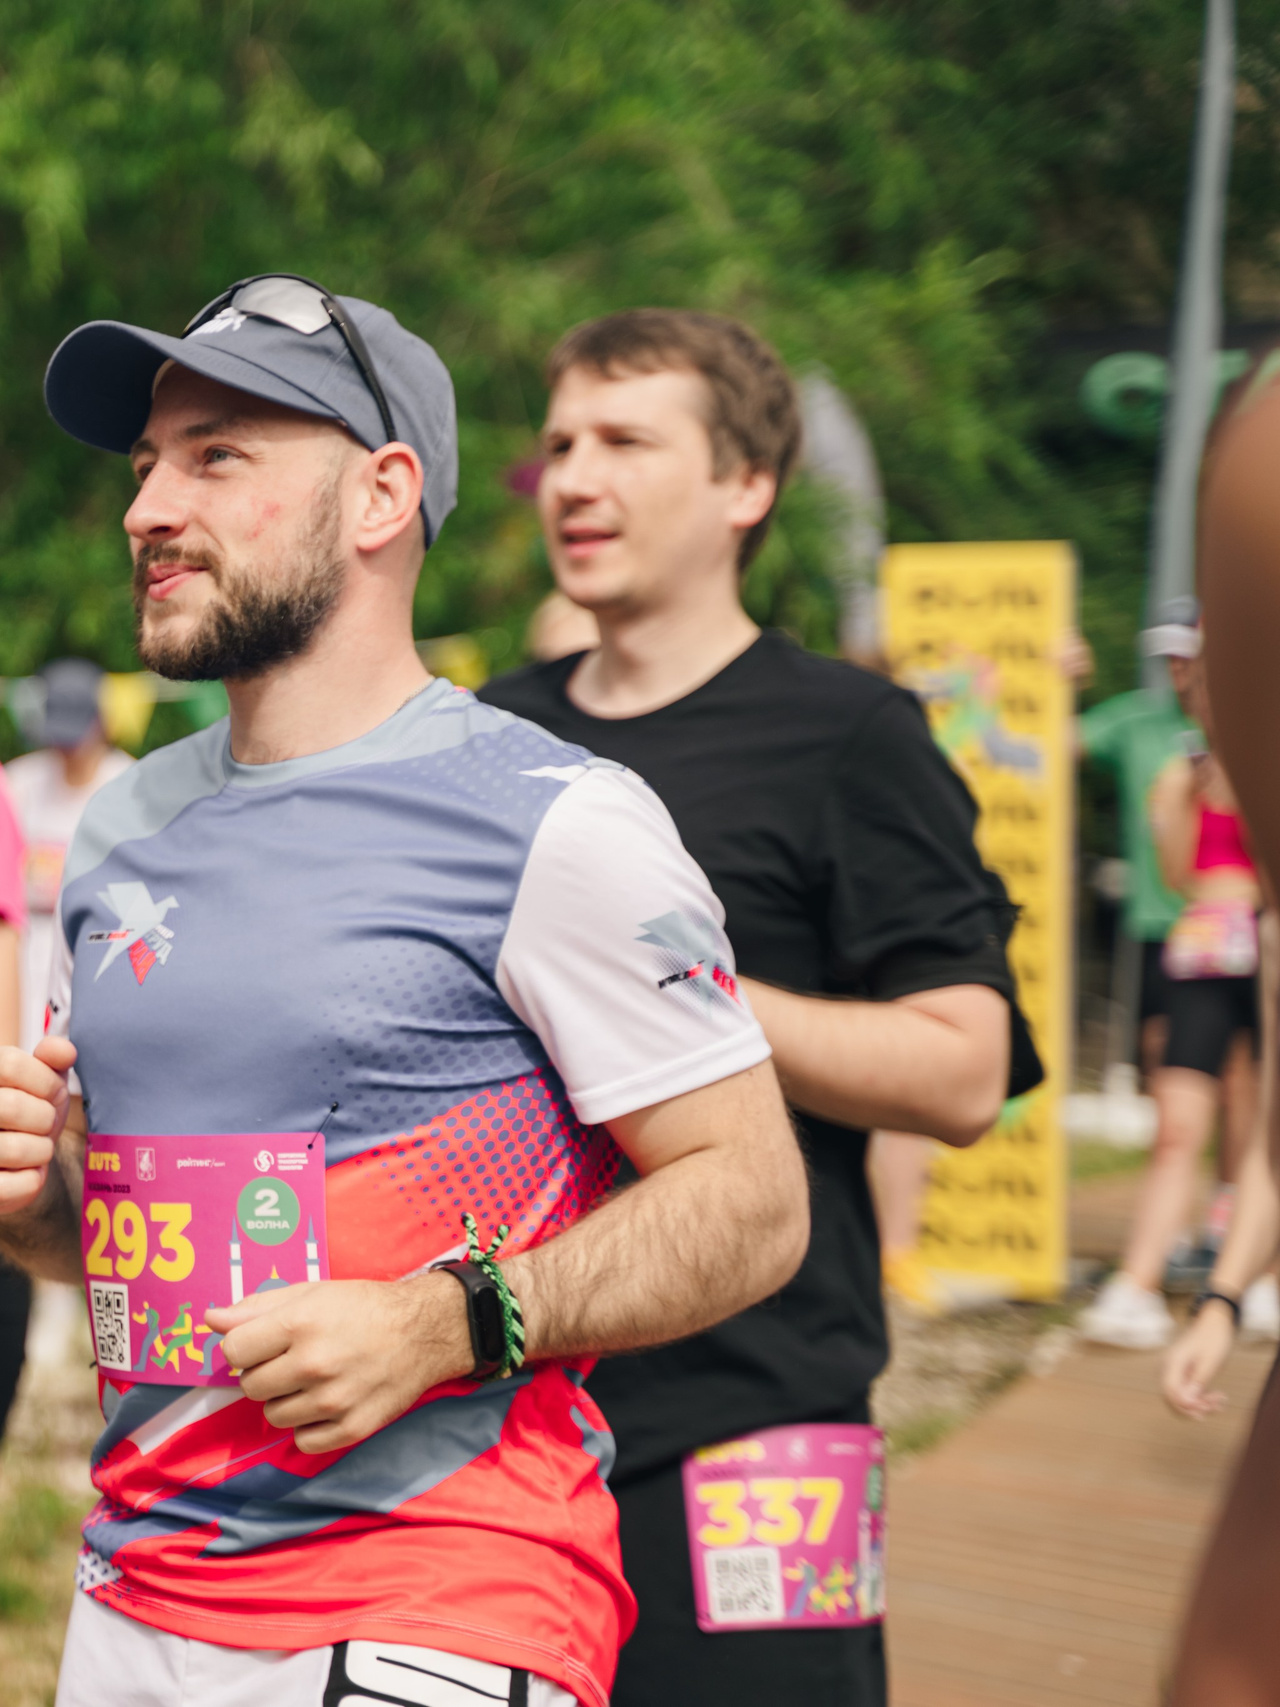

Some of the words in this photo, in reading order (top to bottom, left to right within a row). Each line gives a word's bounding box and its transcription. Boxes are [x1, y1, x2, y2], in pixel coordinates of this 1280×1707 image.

[246, 1220, 290, 1230] ВОЛНА
[254, 1188, 280, 1216] 2
[85, 1198, 195, 1282] 293
[695, 1477, 843, 1546] 337
